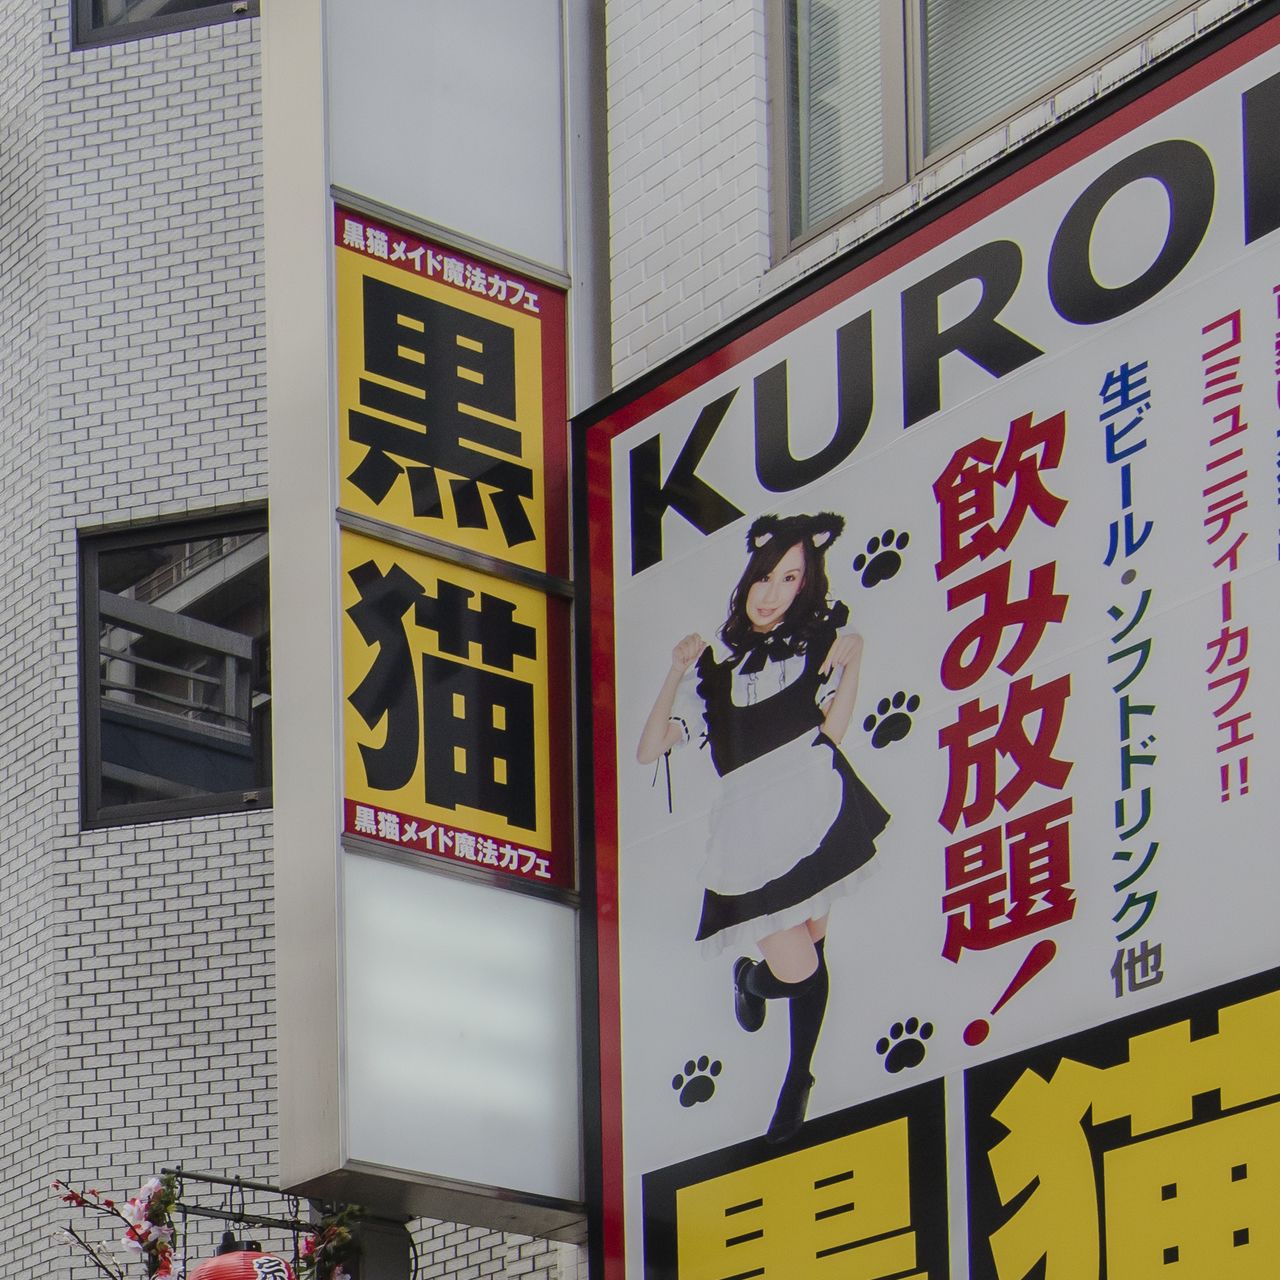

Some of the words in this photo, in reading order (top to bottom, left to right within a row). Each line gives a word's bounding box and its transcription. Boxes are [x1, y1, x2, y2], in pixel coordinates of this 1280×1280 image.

[342, 218, 540, 313] 黒猫メイド魔法カフェ
[629, 72, 1280, 577] KURO
[345, 273, 537, 832] 黒猫
[353, 806, 552, 879] 黒猫メイド魔法カフェ
